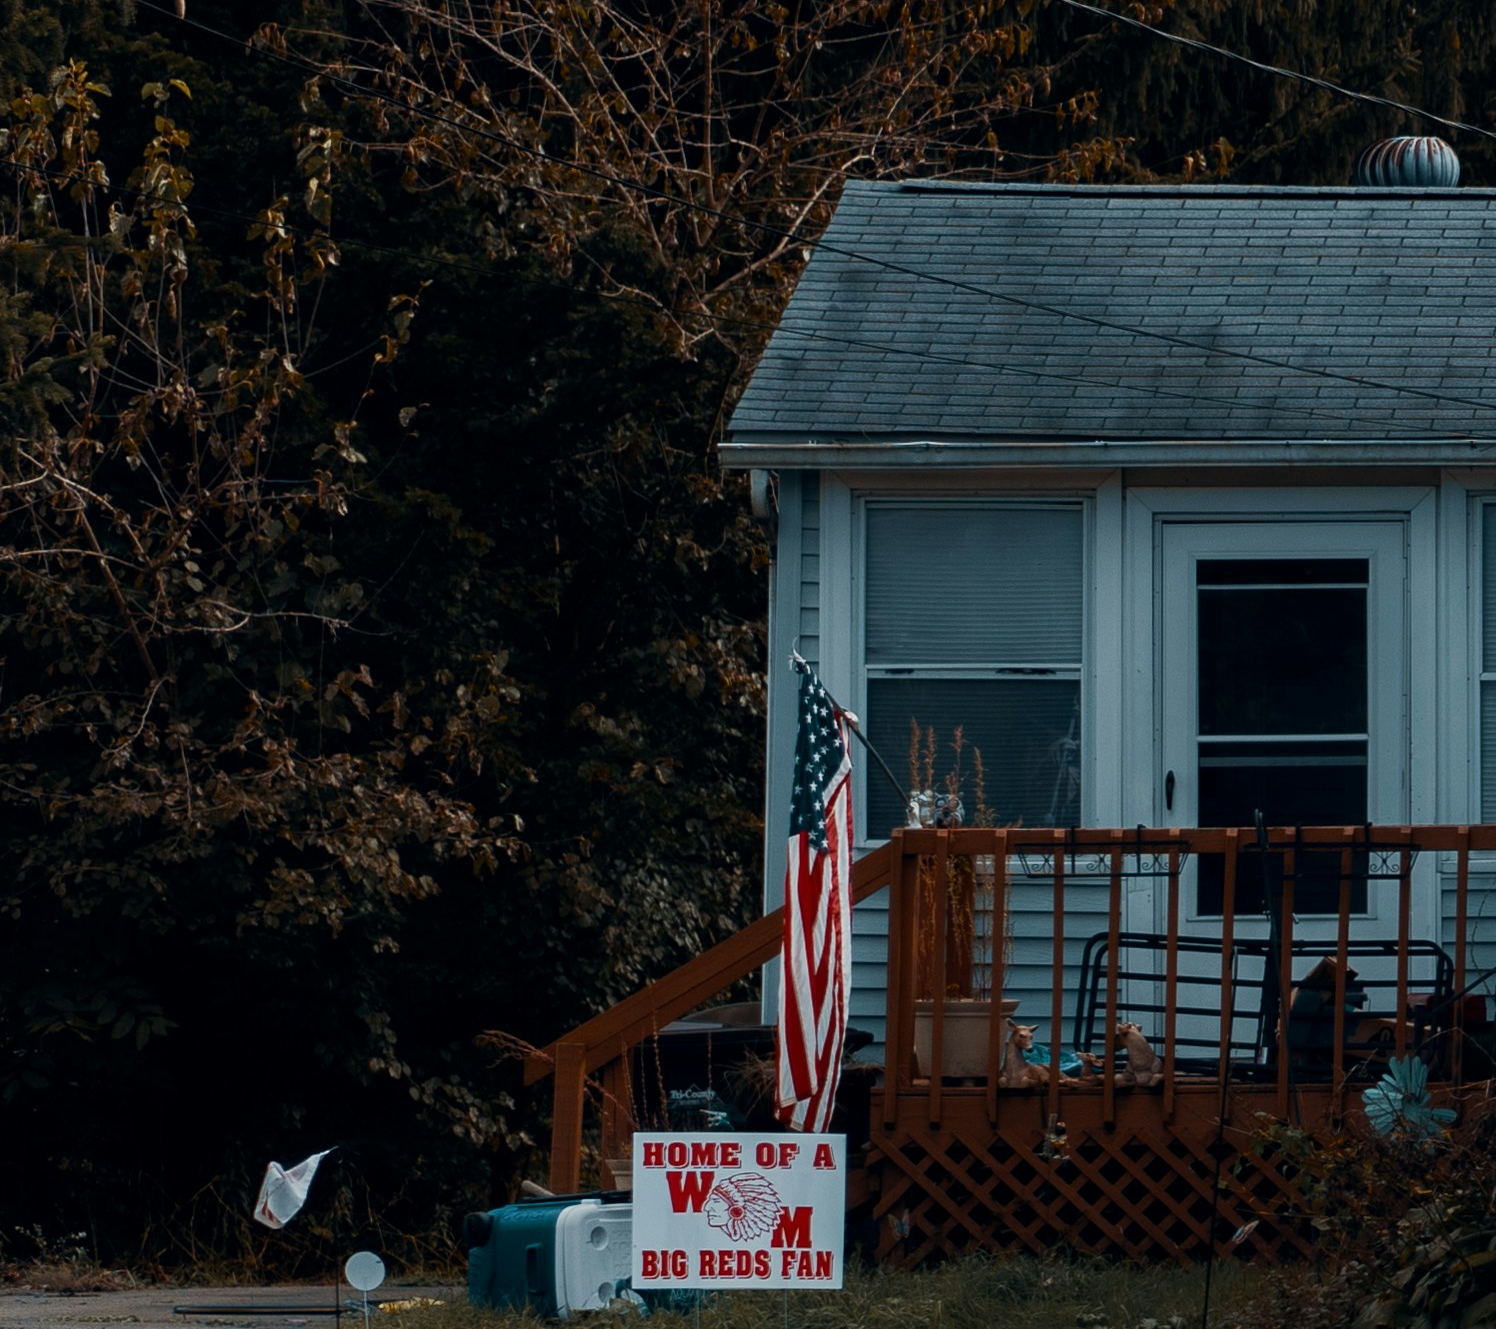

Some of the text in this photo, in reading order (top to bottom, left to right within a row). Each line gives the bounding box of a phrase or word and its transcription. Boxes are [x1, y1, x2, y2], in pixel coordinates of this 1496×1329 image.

[643, 1142, 836, 1169] HOME OF A
[666, 1171, 715, 1213] W
[770, 1206, 813, 1248] M
[642, 1250, 689, 1279] BIG
[699, 1250, 770, 1279] REDS
[781, 1251, 834, 1280] FAN
